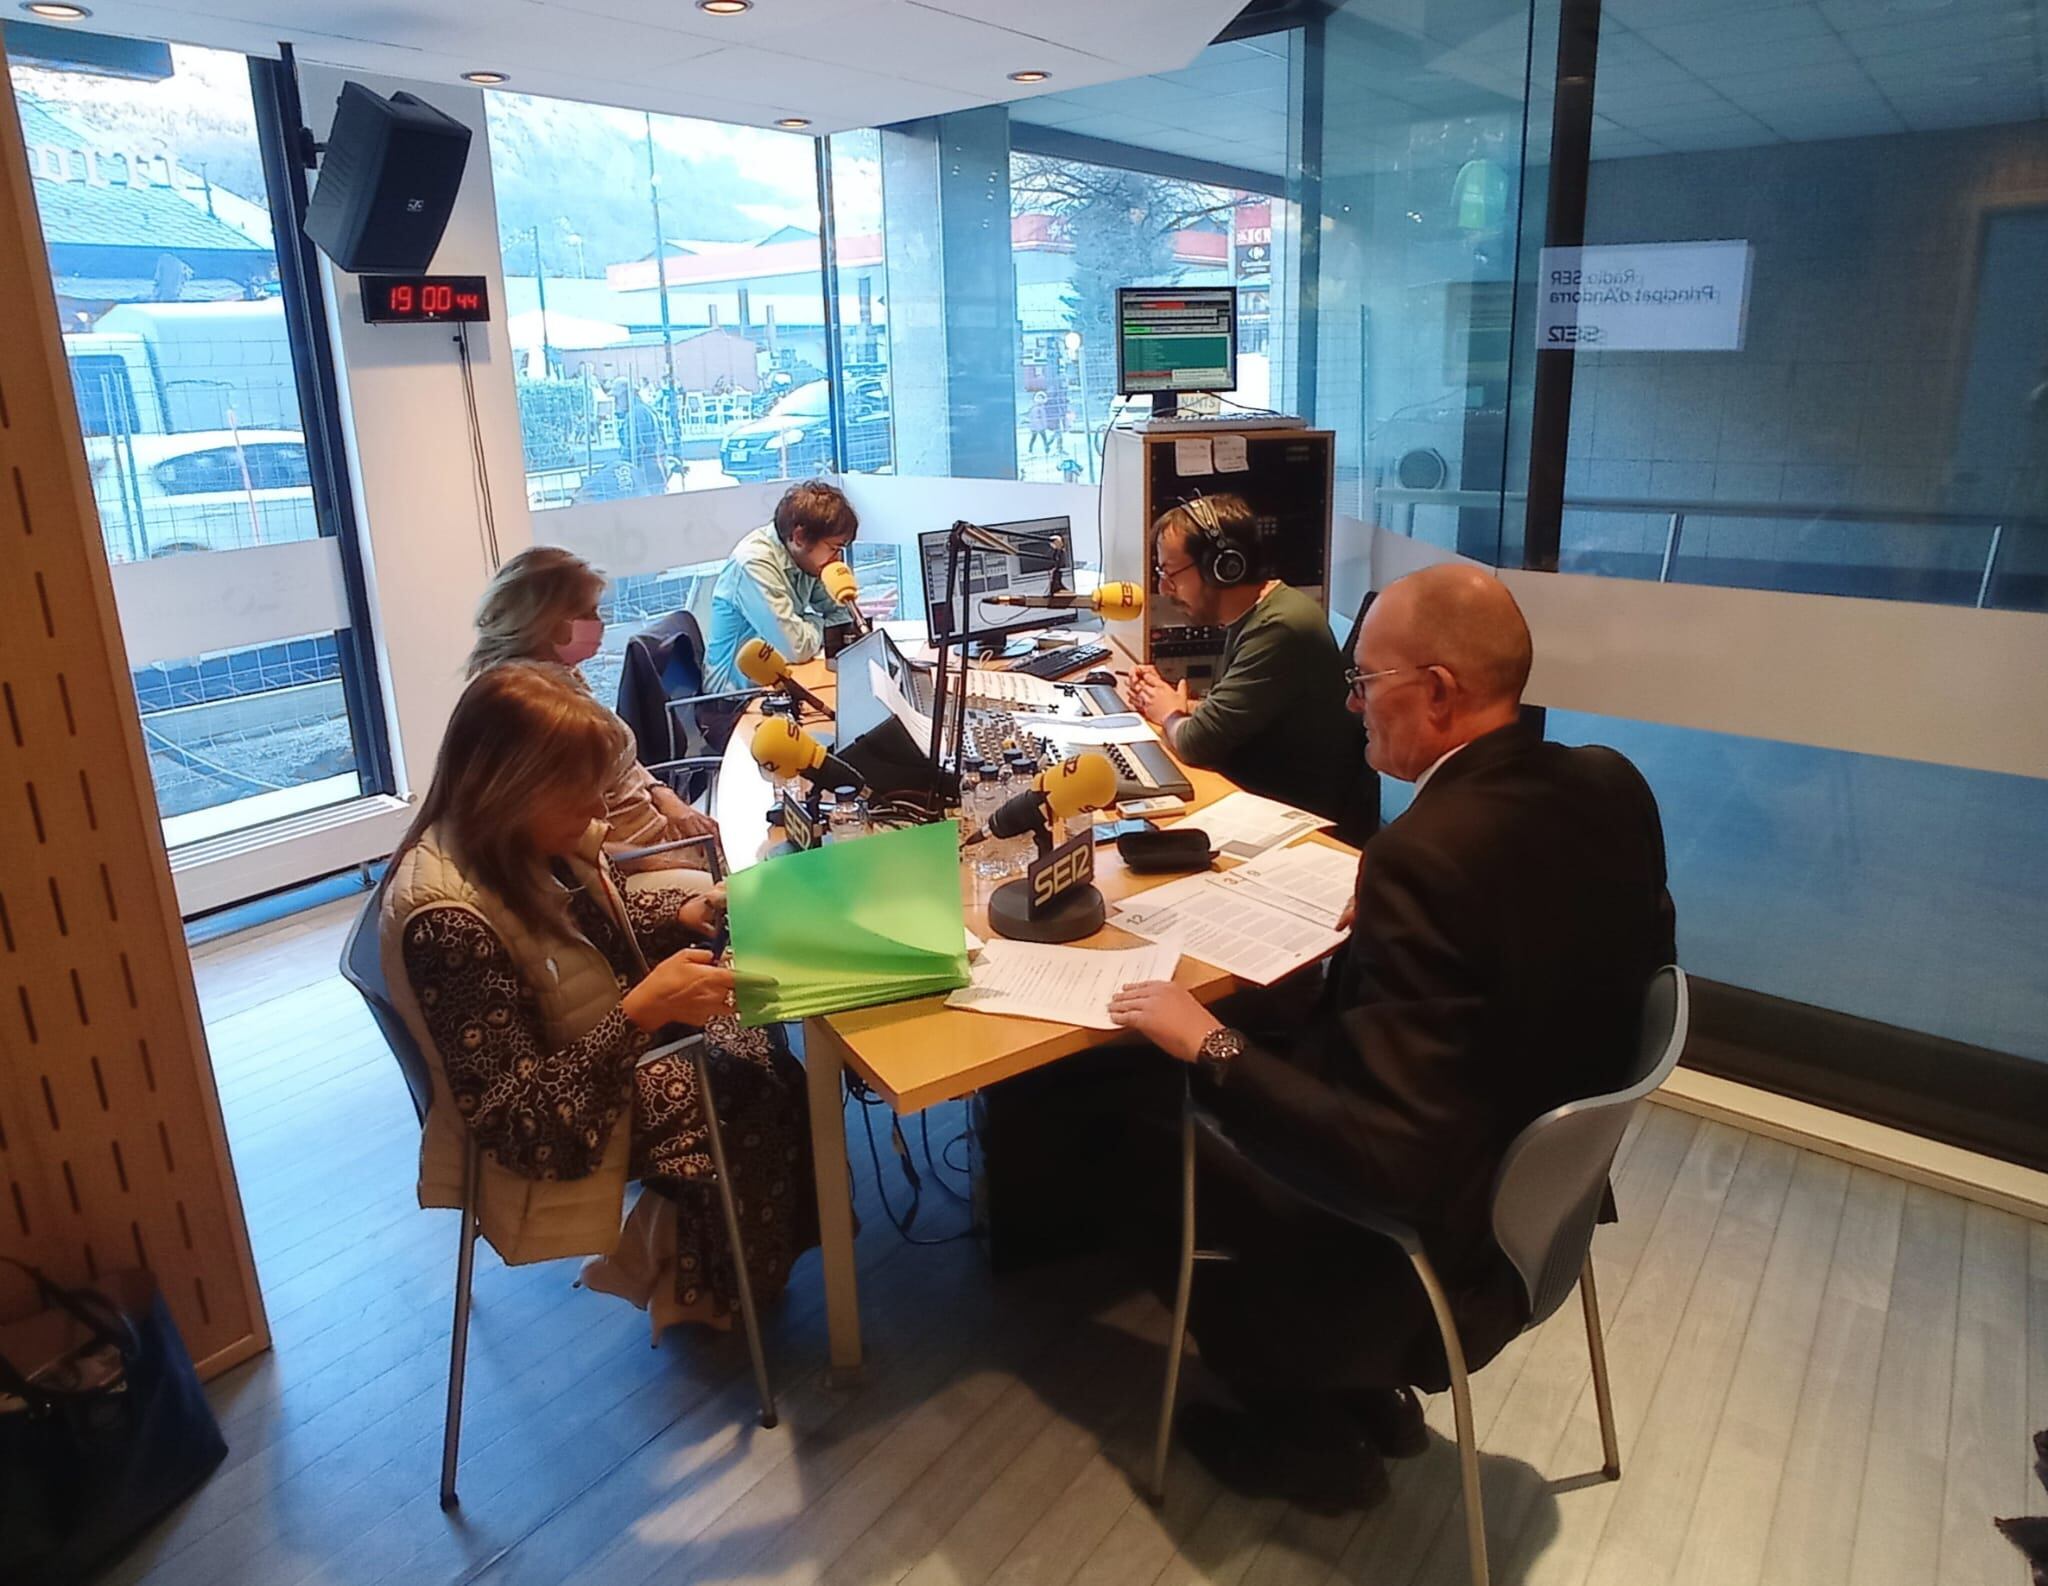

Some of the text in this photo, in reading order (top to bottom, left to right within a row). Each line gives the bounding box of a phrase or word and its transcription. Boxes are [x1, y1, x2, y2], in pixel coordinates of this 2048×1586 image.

[391, 285, 478, 311] 19 00 44
[1034, 844, 1091, 907] SER
